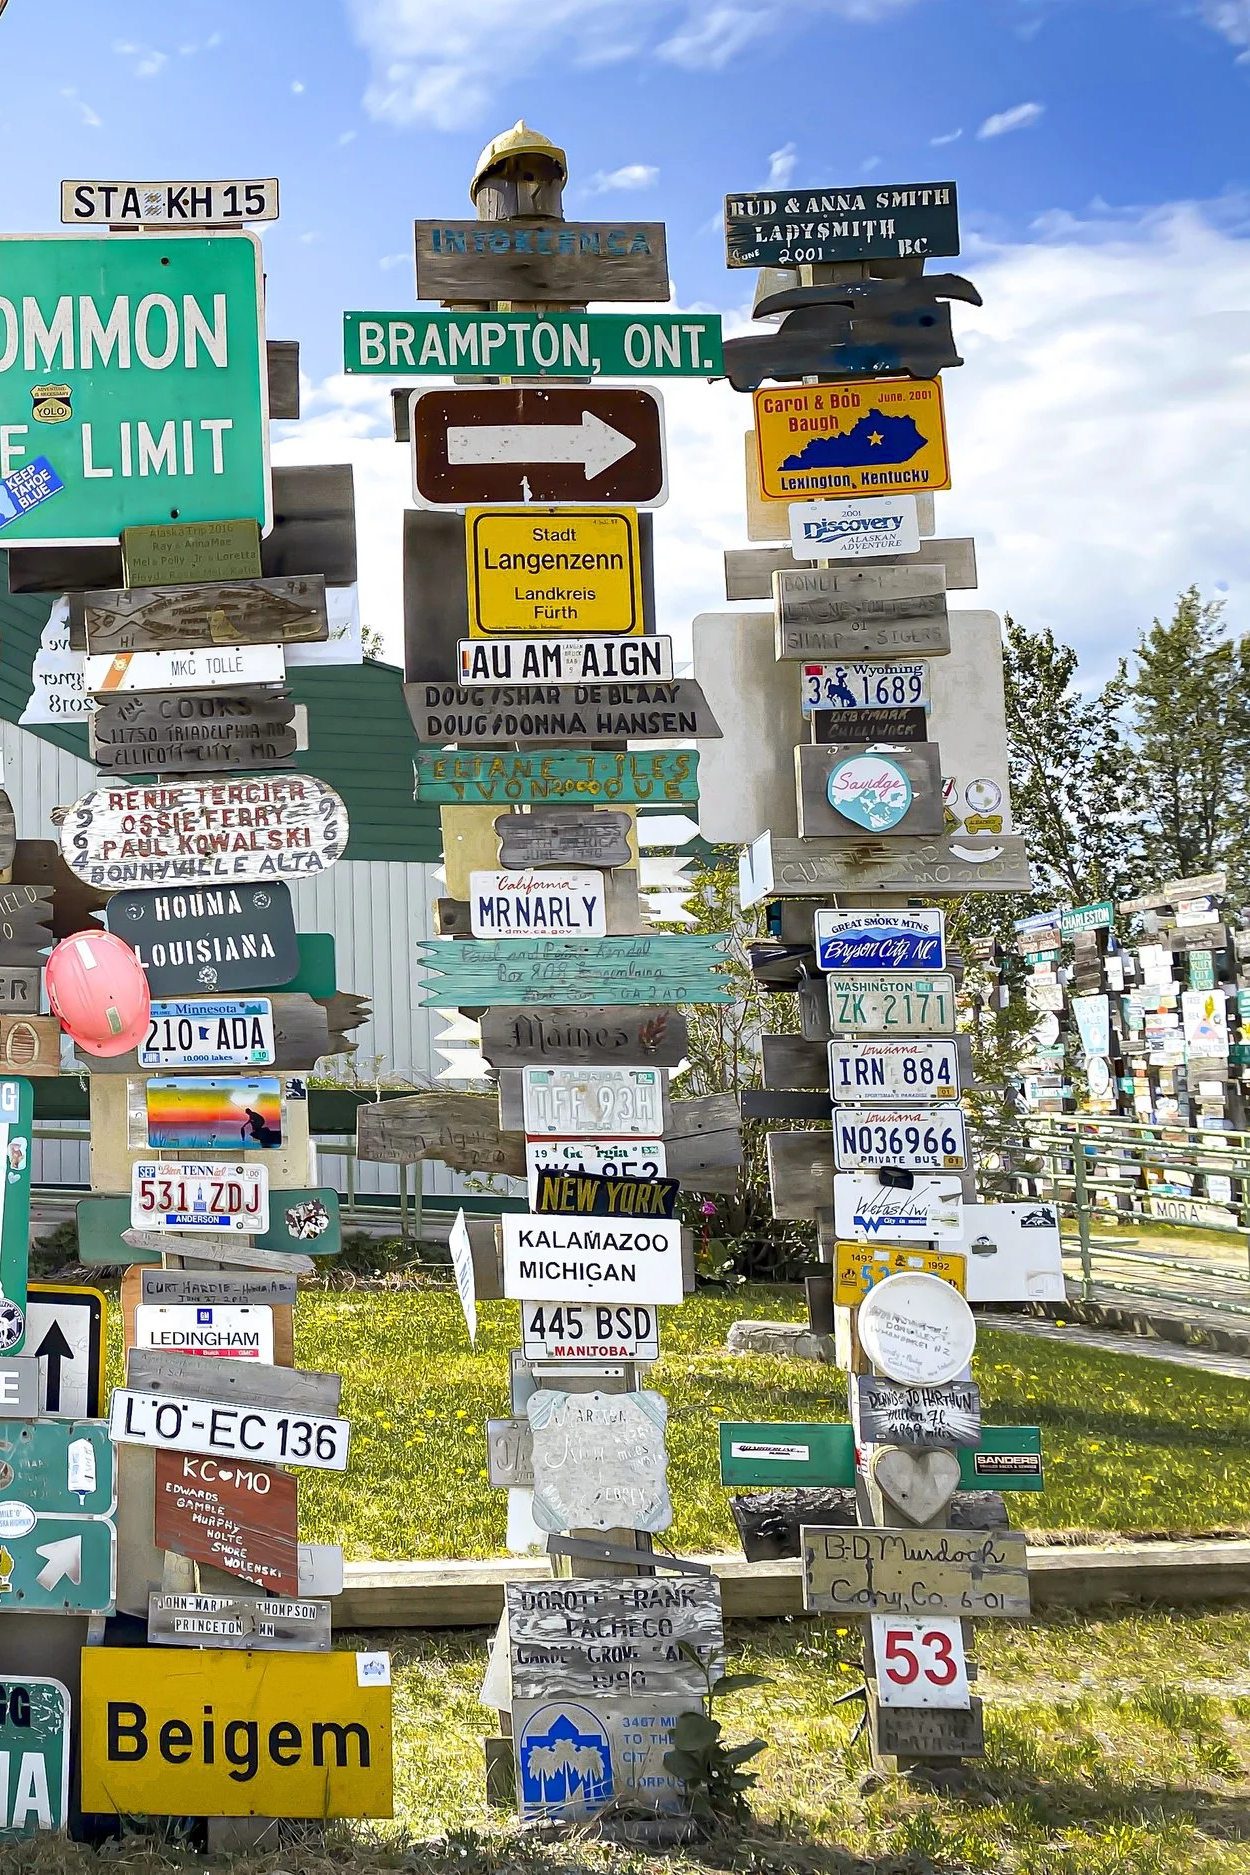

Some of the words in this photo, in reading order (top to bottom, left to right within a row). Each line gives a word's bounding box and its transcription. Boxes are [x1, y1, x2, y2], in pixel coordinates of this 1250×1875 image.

[805, 194, 866, 214] ANNA
[877, 189, 950, 208] SMITH
[756, 219, 895, 247] LADYSMITH
[359, 321, 602, 374] BRAMPTON,
[624, 324, 713, 369] ONT.
[764, 395, 809, 413] Carol
[815, 396, 824, 409] &
[831, 393, 861, 409] Bob
[910, 391, 932, 401] 2001
[36, 406, 66, 419] YOLO
[789, 414, 839, 432] Baugh
[81, 418, 234, 480] LIMIT
[6, 464, 37, 488] KEEP
[12, 469, 51, 498] TAHOE
[781, 473, 857, 491] Lexington,
[862, 470, 929, 485] Kentucky
[18, 481, 50, 511] BLUE
[532, 528, 577, 542] Stadt
[803, 516, 904, 540] Discovery
[841, 540, 902, 551] ADVENTURE
[849, 534, 897, 543] ALASKAN
[484, 548, 624, 574] Langenzenn
[515, 587, 596, 601] Landkreis
[534, 605, 578, 620] Fürth
[207, 656, 244, 673] TOLLE
[471, 645, 511, 679] AU
[522, 644, 562, 679] AM
[581, 642, 661, 677] AIGN
[853, 664, 923, 676] Wyoming
[808, 676, 821, 704] 3
[863, 676, 921, 705] 1689
[103, 840, 167, 859] PAUL
[498, 877, 577, 894] California
[154, 890, 243, 921] HOUMA
[831, 920, 863, 934] GREAT
[864, 917, 899, 926] SMOKY
[1062, 907, 1109, 928] CHARLESTON
[135, 932, 276, 968] LOUISIANA
[834, 982, 913, 992] WASHINGTON
[175, 1004, 237, 1015] Minnesota
[218, 1017, 265, 1050] ADA
[211, 1054, 233, 1062] lakes
[860, 1043, 923, 1056] Louisiana
[839, 1058, 885, 1085] IRN
[904, 1057, 950, 1085] 884
[865, 1112, 928, 1124] Louisiana
[861, 1155, 905, 1164] PRIVATE
[914, 1155, 938, 1164] BUS
[141, 1181, 188, 1211] 531
[210, 1182, 259, 1213] ZDJ
[540, 1176, 601, 1212] NEW
[605, 1182, 673, 1215] YORK
[176, 1215, 219, 1224] ANDERSON
[519, 1230, 668, 1252] KALAMAZOO
[520, 1261, 636, 1282] MICHIGAN
[928, 1261, 950, 1270] 1992
[147, 1282, 178, 1294] CURT
[183, 1281, 231, 1294] HARDIE
[530, 1307, 583, 1340] 445
[596, 1307, 651, 1340] BSD
[151, 1332, 259, 1346] LEDINGHAM
[555, 1346, 628, 1356] MANITOBA
[977, 1455, 1038, 1465] SANDERS
[165, 1482, 219, 1502] EDWARDS
[177, 1498, 225, 1516] GAMBLE
[175, 1619, 243, 1635] PRINCETON
[259, 1623, 275, 1637] MN
[885, 1630, 958, 1687] 53
[108, 1702, 371, 1782] Beigem
